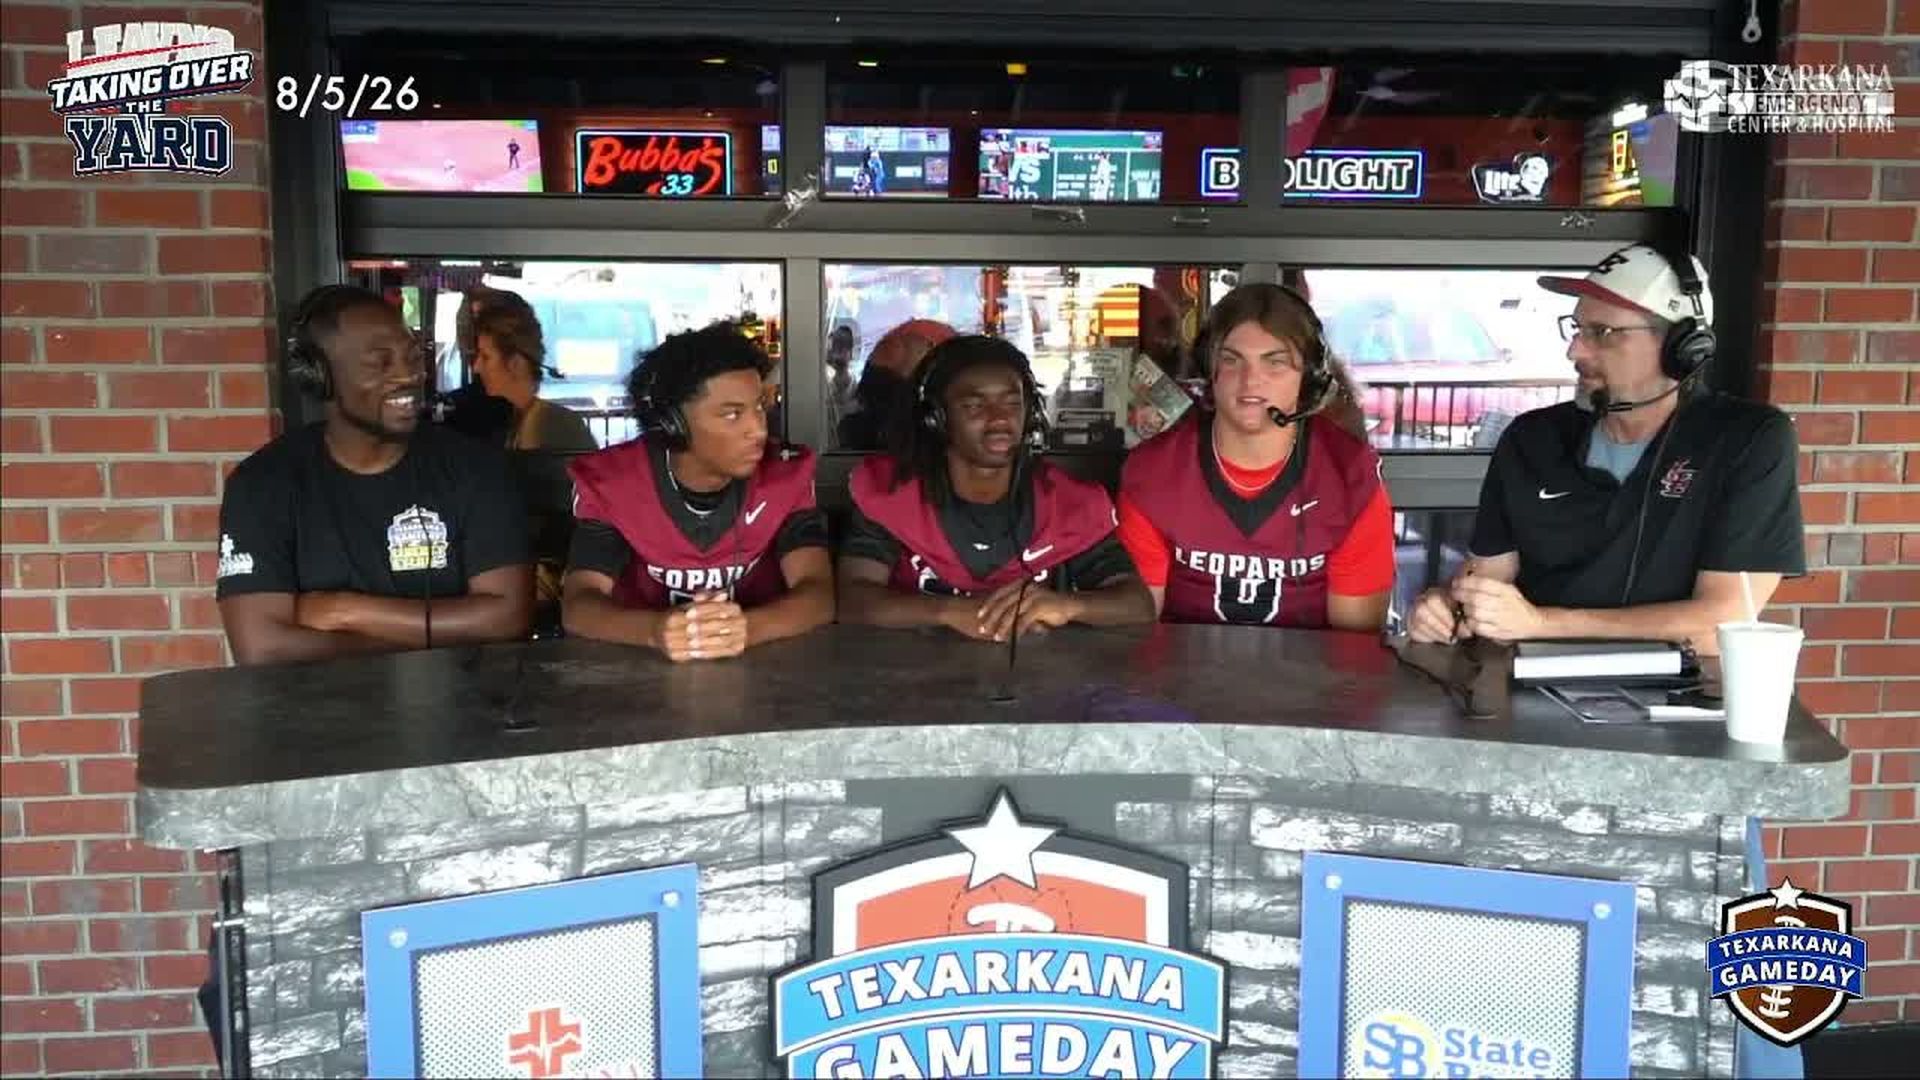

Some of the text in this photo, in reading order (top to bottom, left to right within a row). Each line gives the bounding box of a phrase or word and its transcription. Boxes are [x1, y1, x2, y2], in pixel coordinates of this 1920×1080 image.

[584, 136, 724, 194] Bubba's
[660, 174, 695, 194] 33
[1296, 158, 1413, 191] LIGHT
[1175, 546, 1326, 578] LEOPARDS
[809, 949, 1186, 1020] TEXARKANA
[813, 1021, 1197, 1079] GAMEDAY
[1363, 1022, 1552, 1078] SB State
